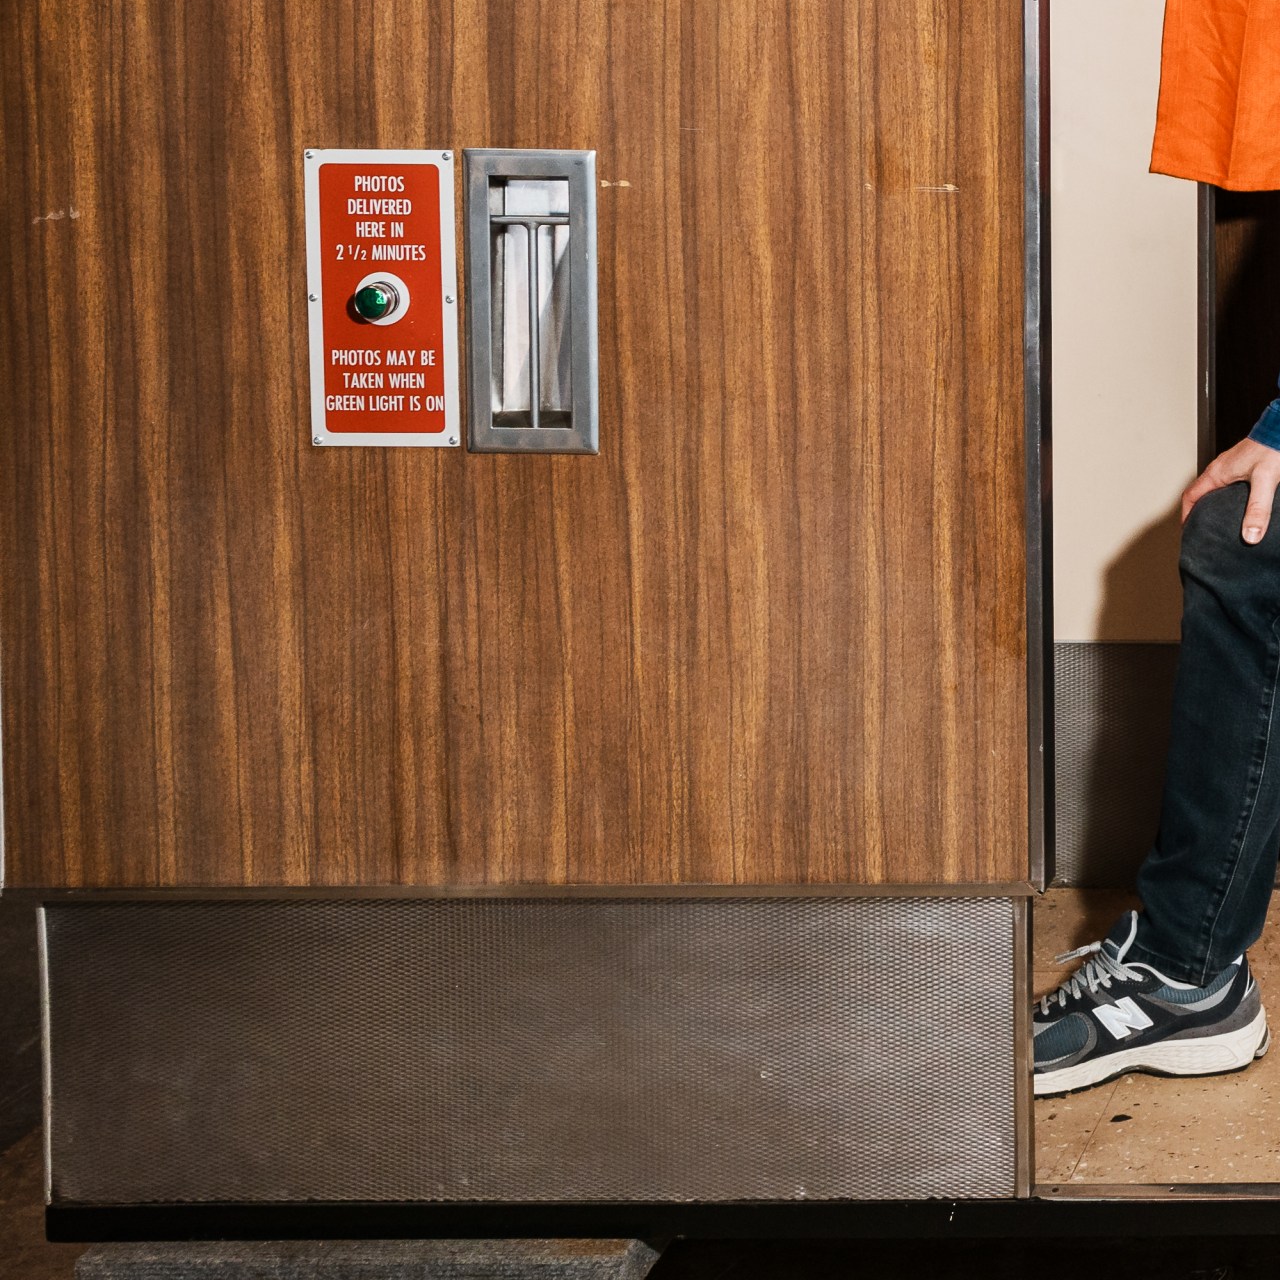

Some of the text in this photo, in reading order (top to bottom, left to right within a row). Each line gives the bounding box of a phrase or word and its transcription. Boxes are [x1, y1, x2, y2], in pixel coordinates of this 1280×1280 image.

[354, 175, 405, 193] PHOTOS
[347, 199, 412, 216] DELIVERED
[355, 222, 404, 238] HERE IN
[336, 244, 345, 261] 2
[371, 244, 426, 261] MINUTES
[331, 349, 436, 367] PHOTOS MAY BE
[342, 372, 425, 389] TAKEN WHEN
[325, 395, 445, 412] GREEN LIGHT IS ON
[1092, 996, 1154, 1040] N
